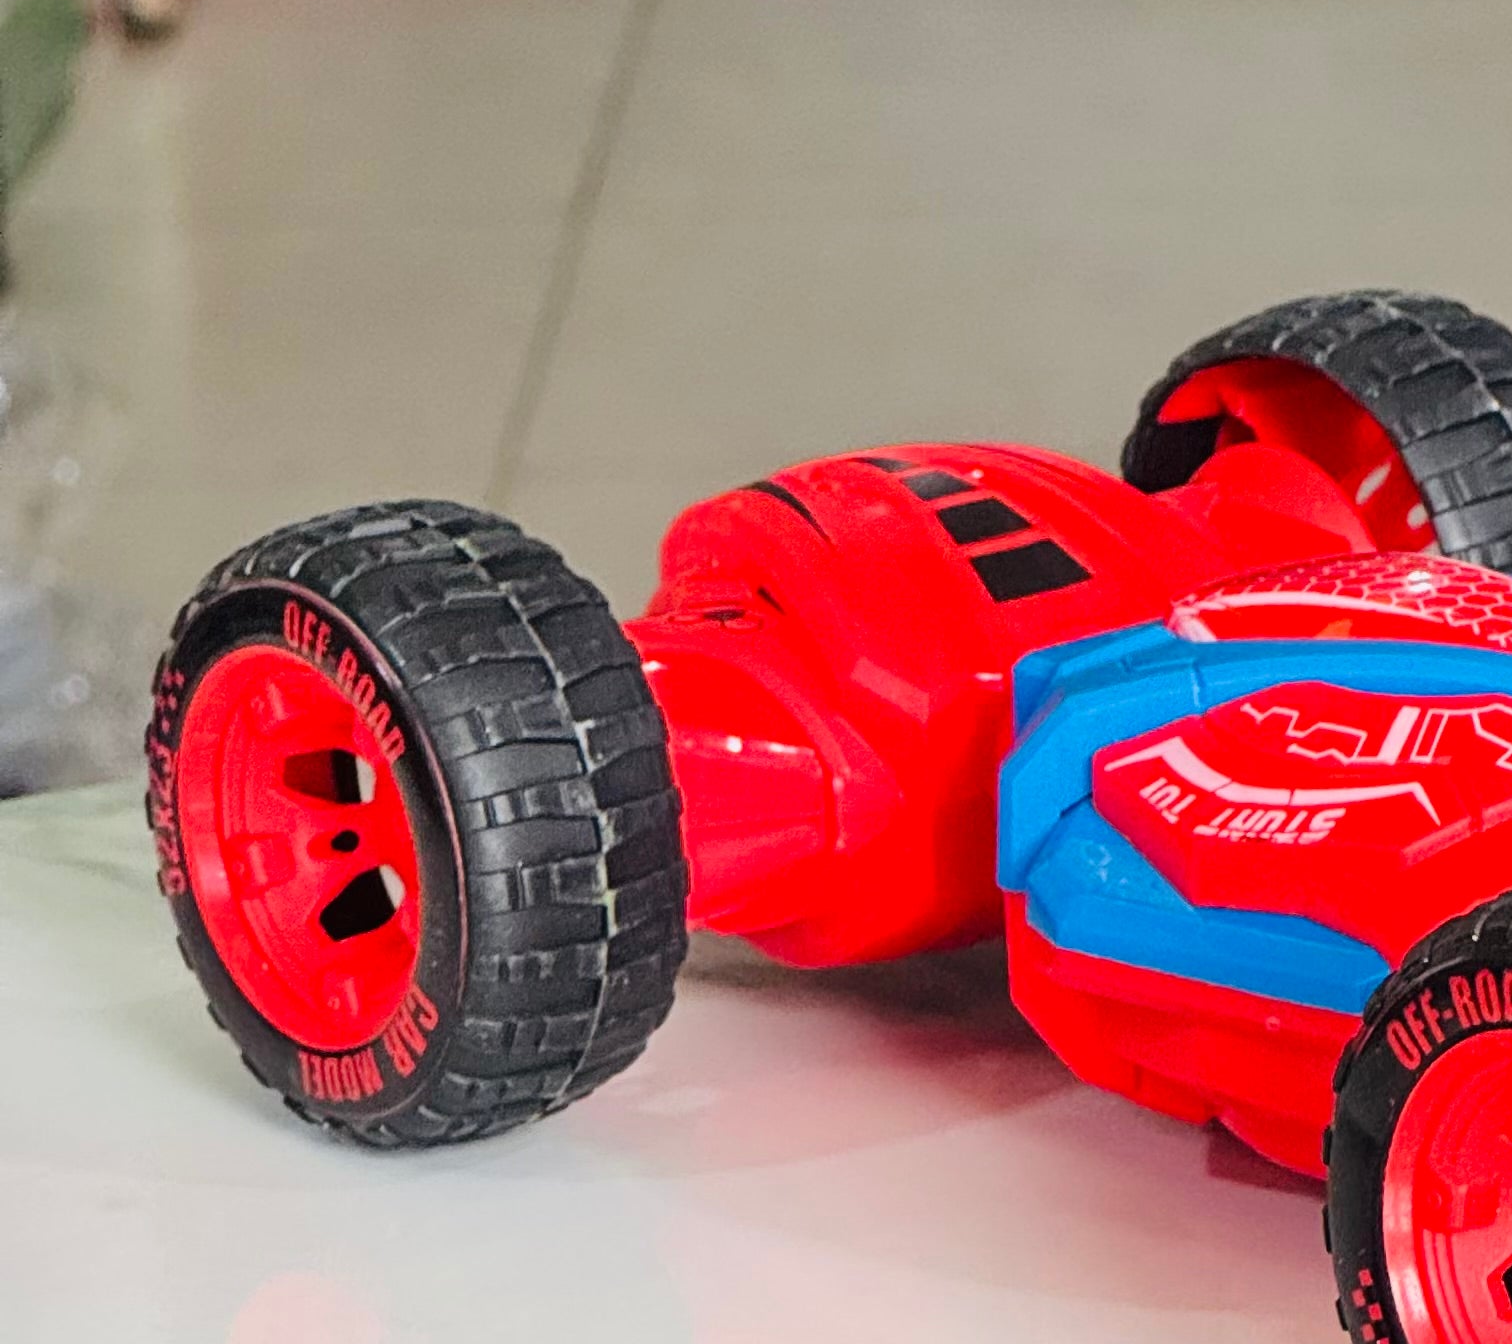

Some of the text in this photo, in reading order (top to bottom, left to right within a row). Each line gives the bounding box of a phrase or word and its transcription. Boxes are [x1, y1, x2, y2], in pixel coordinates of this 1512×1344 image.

[1193, 807, 1347, 846] STUNT
[298, 982, 439, 1103] CAR MODEL
